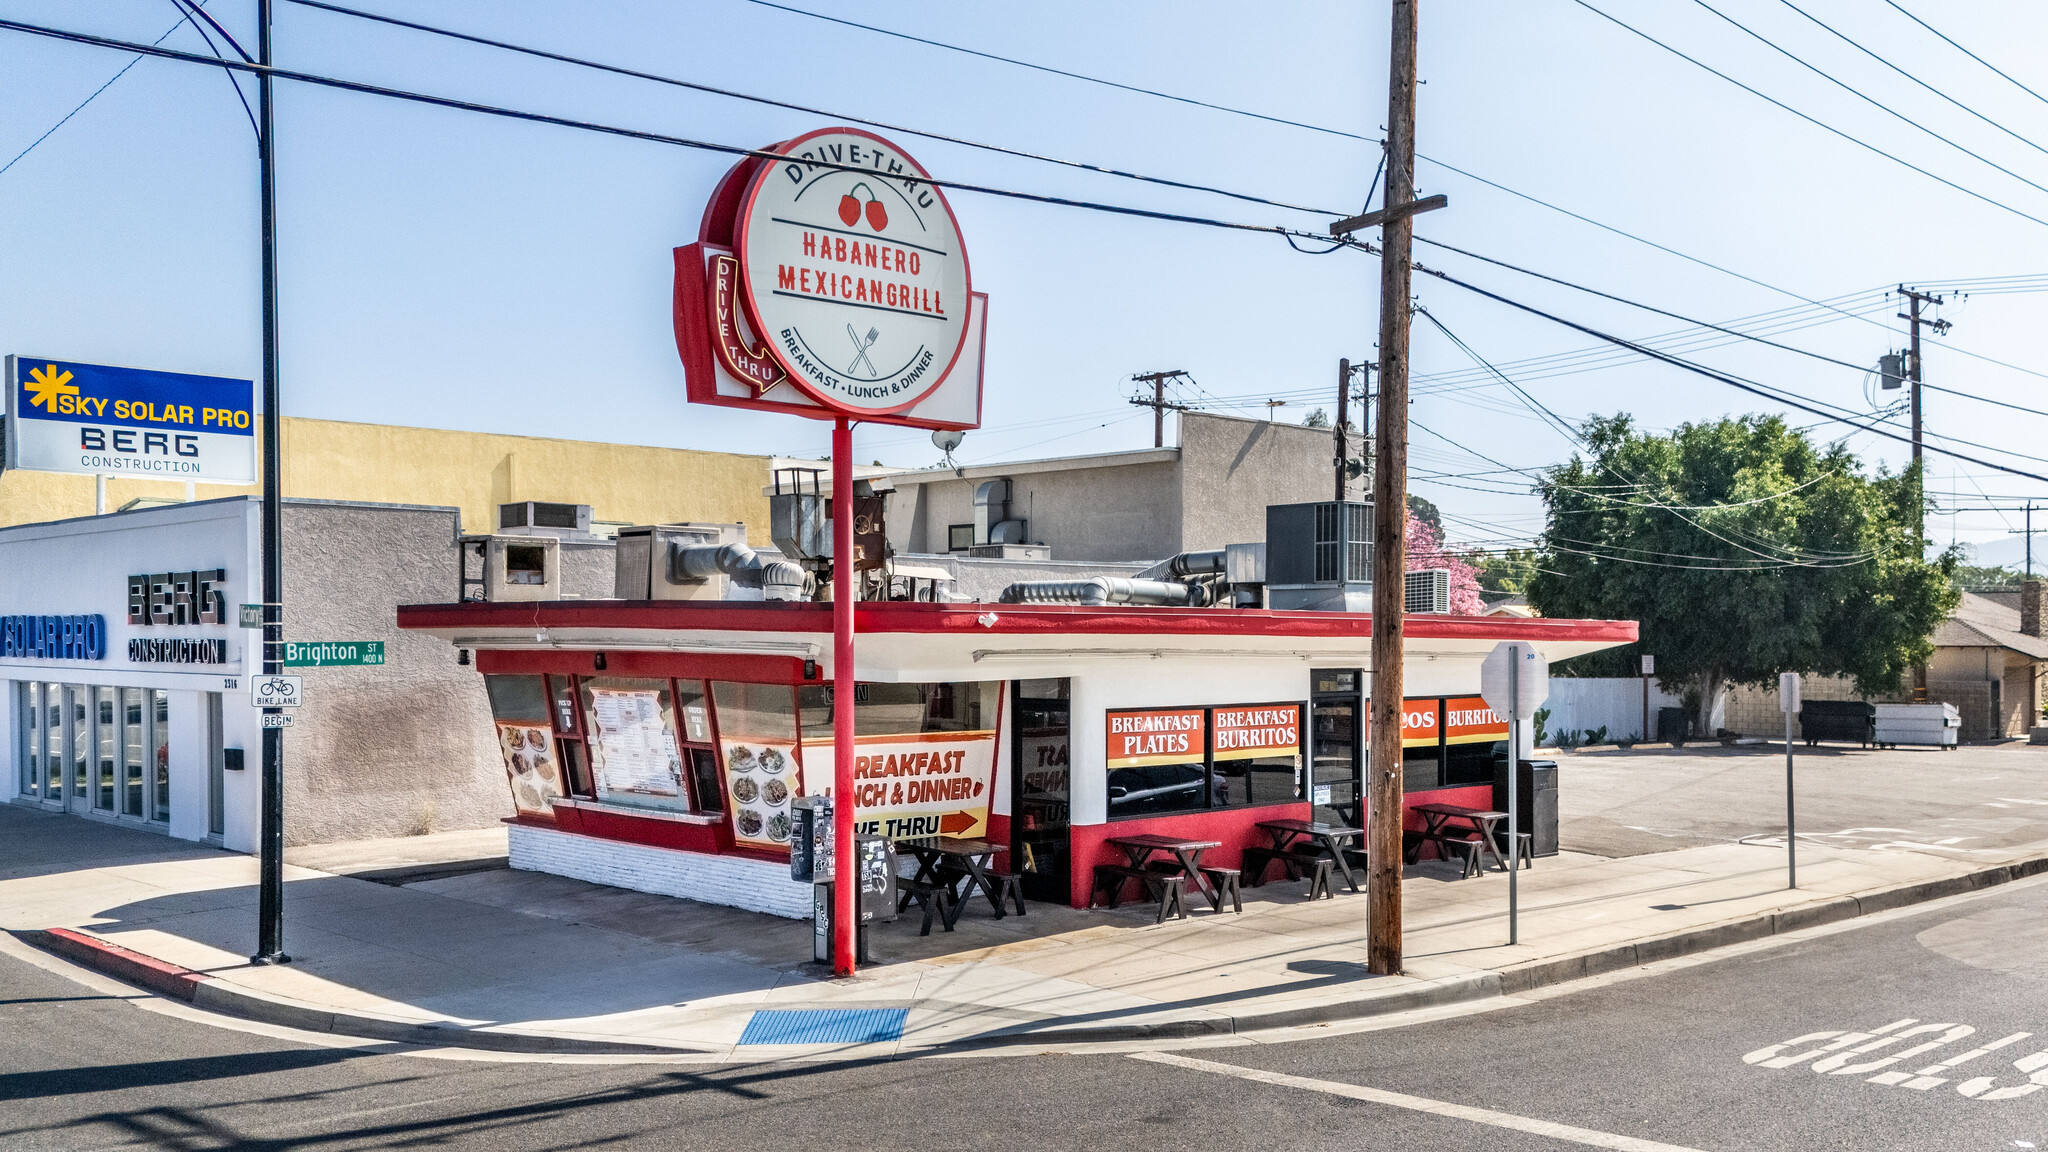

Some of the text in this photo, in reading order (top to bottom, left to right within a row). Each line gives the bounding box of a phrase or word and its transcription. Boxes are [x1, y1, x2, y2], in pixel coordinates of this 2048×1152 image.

[785, 144, 934, 208] DRIVE-THRU
[802, 232, 921, 275] HABANERO
[719, 262, 729, 337] DRIVE
[778, 264, 944, 314] MEXICANGRILL
[729, 346, 772, 380] THRU
[781, 328, 934, 398] BREAKFAST LUNCH & DINNER
[58, 394, 250, 429] SKY SOLAR PRO
[81, 427, 199, 457] BERG
[81, 455, 200, 473] CONSTRUCTION
[128, 569, 224, 625] BERG
[5, 613, 104, 661] SOLAR PRO
[128, 638, 221, 664] CONSTRUCTION
[286, 643, 377, 666] Brighton ST
[362, 654, 383, 663] 1400 N
[224, 679, 238, 689] 2316
[256, 697, 297, 705] BIKE LANE
[264, 715, 292, 727] BEGIN
[1112, 715, 1200, 734] BREAKFAST
[1217, 710, 1296, 728] BREAKFAST
[1124, 733, 1189, 755] PLATES
[1217, 727, 1297, 749] BURRITOS
[854, 751, 965, 779] REAKFAST
[890, 782, 904, 806] &
[907, 777, 973, 804] DINNER
[885, 815, 940, 837] THRU
